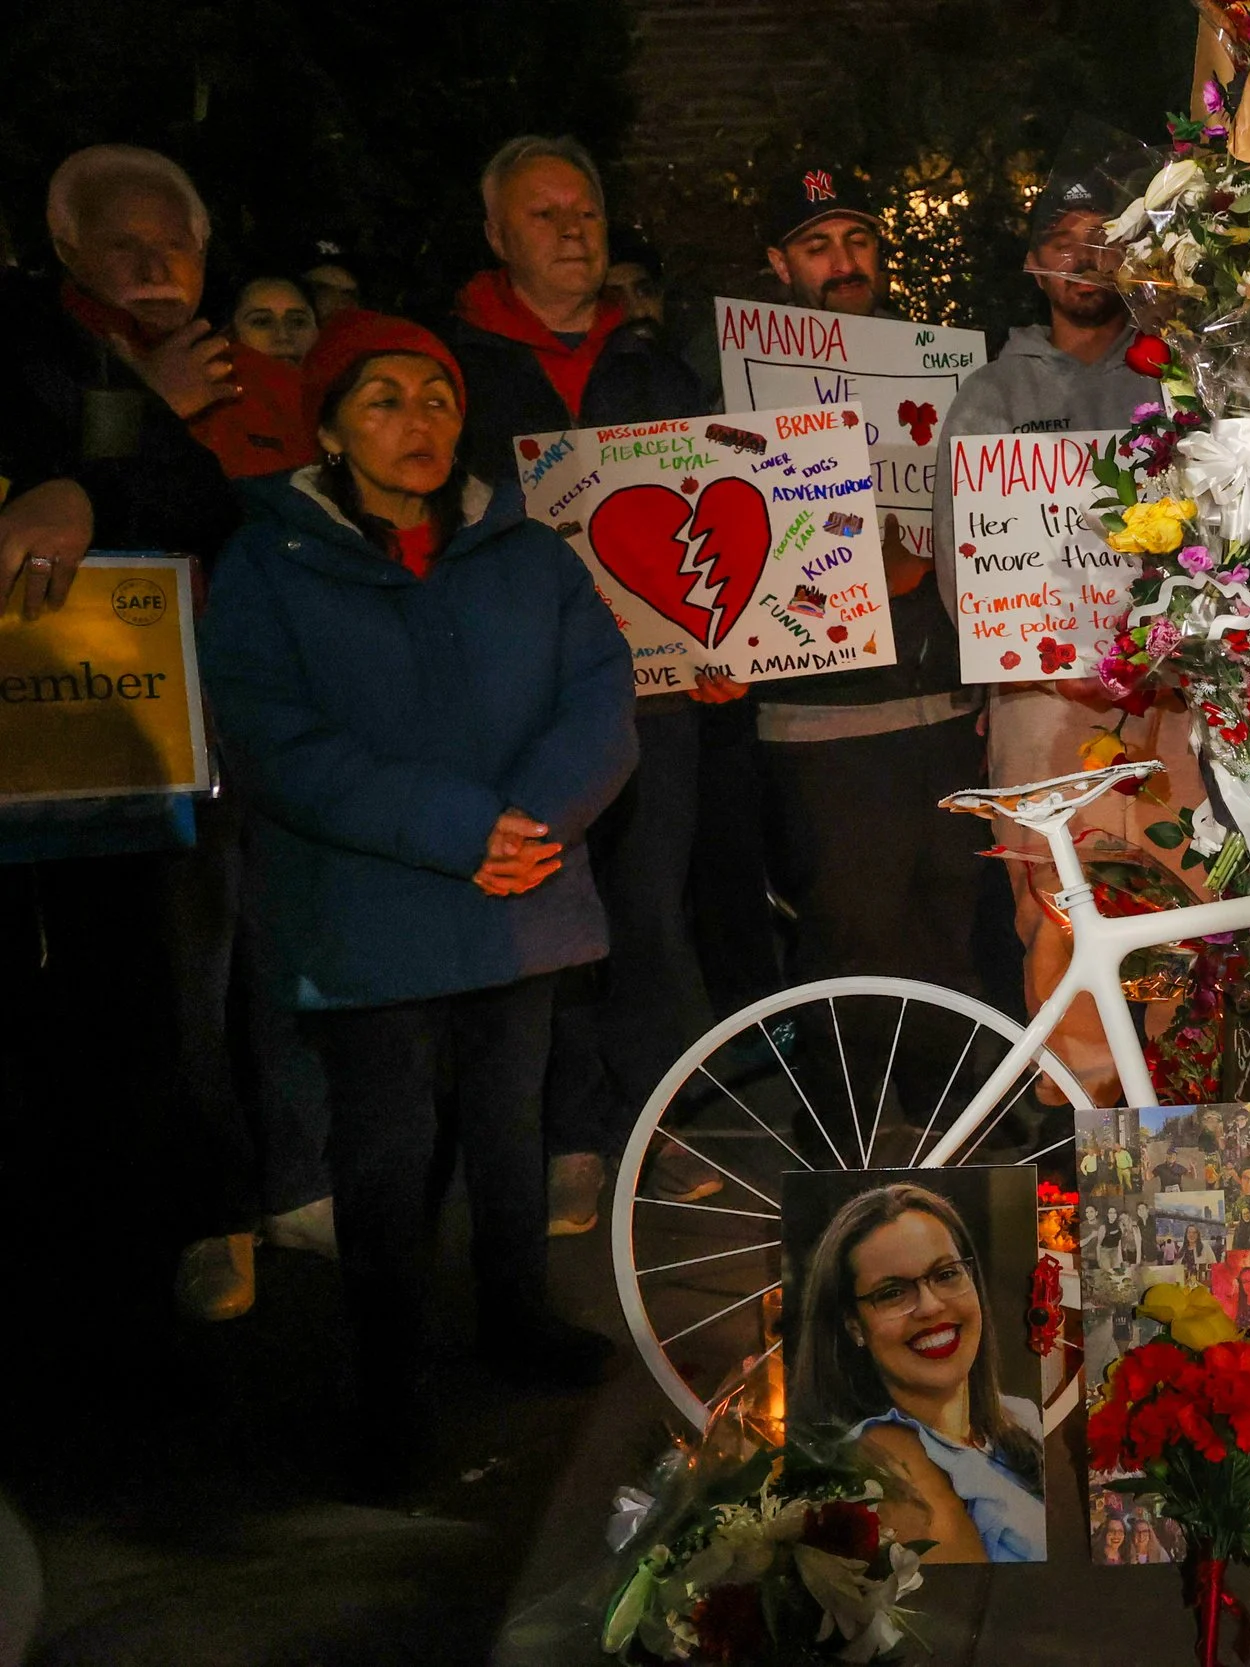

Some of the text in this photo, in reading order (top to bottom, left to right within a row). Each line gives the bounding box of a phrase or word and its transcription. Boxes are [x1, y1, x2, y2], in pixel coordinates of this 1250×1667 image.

[722, 305, 848, 363] AMANDA
[915, 329, 935, 347] NO
[922, 351, 974, 369] CHASE!
[596, 421, 691, 442] PASSIONATE
[774, 411, 839, 440] BRAVE
[599, 436, 697, 466] FIERCELY
[659, 452, 719, 471] LOYAL
[750, 452, 792, 474] LOVER
[802, 456, 838, 479] DOGS
[548, 470, 601, 518] CYCLIST
[968, 503, 1093, 538] Her life
[773, 508, 815, 561] FOOTBALL
[793, 524, 816, 552] FAN
[801, 546, 853, 582] KIND
[973, 550, 1045, 575] more
[115, 594, 162, 610] SAFE
[828, 582, 871, 608] CITY
[1079, 584, 1121, 606] the
[757, 594, 816, 647] FUNNY
[839, 601, 883, 623] GIRL
[971, 619, 1013, 640] the
[1020, 616, 1081, 642] police
[633, 666, 681, 687] OVE
[749, 646, 858, 676] AMANDA!!!
